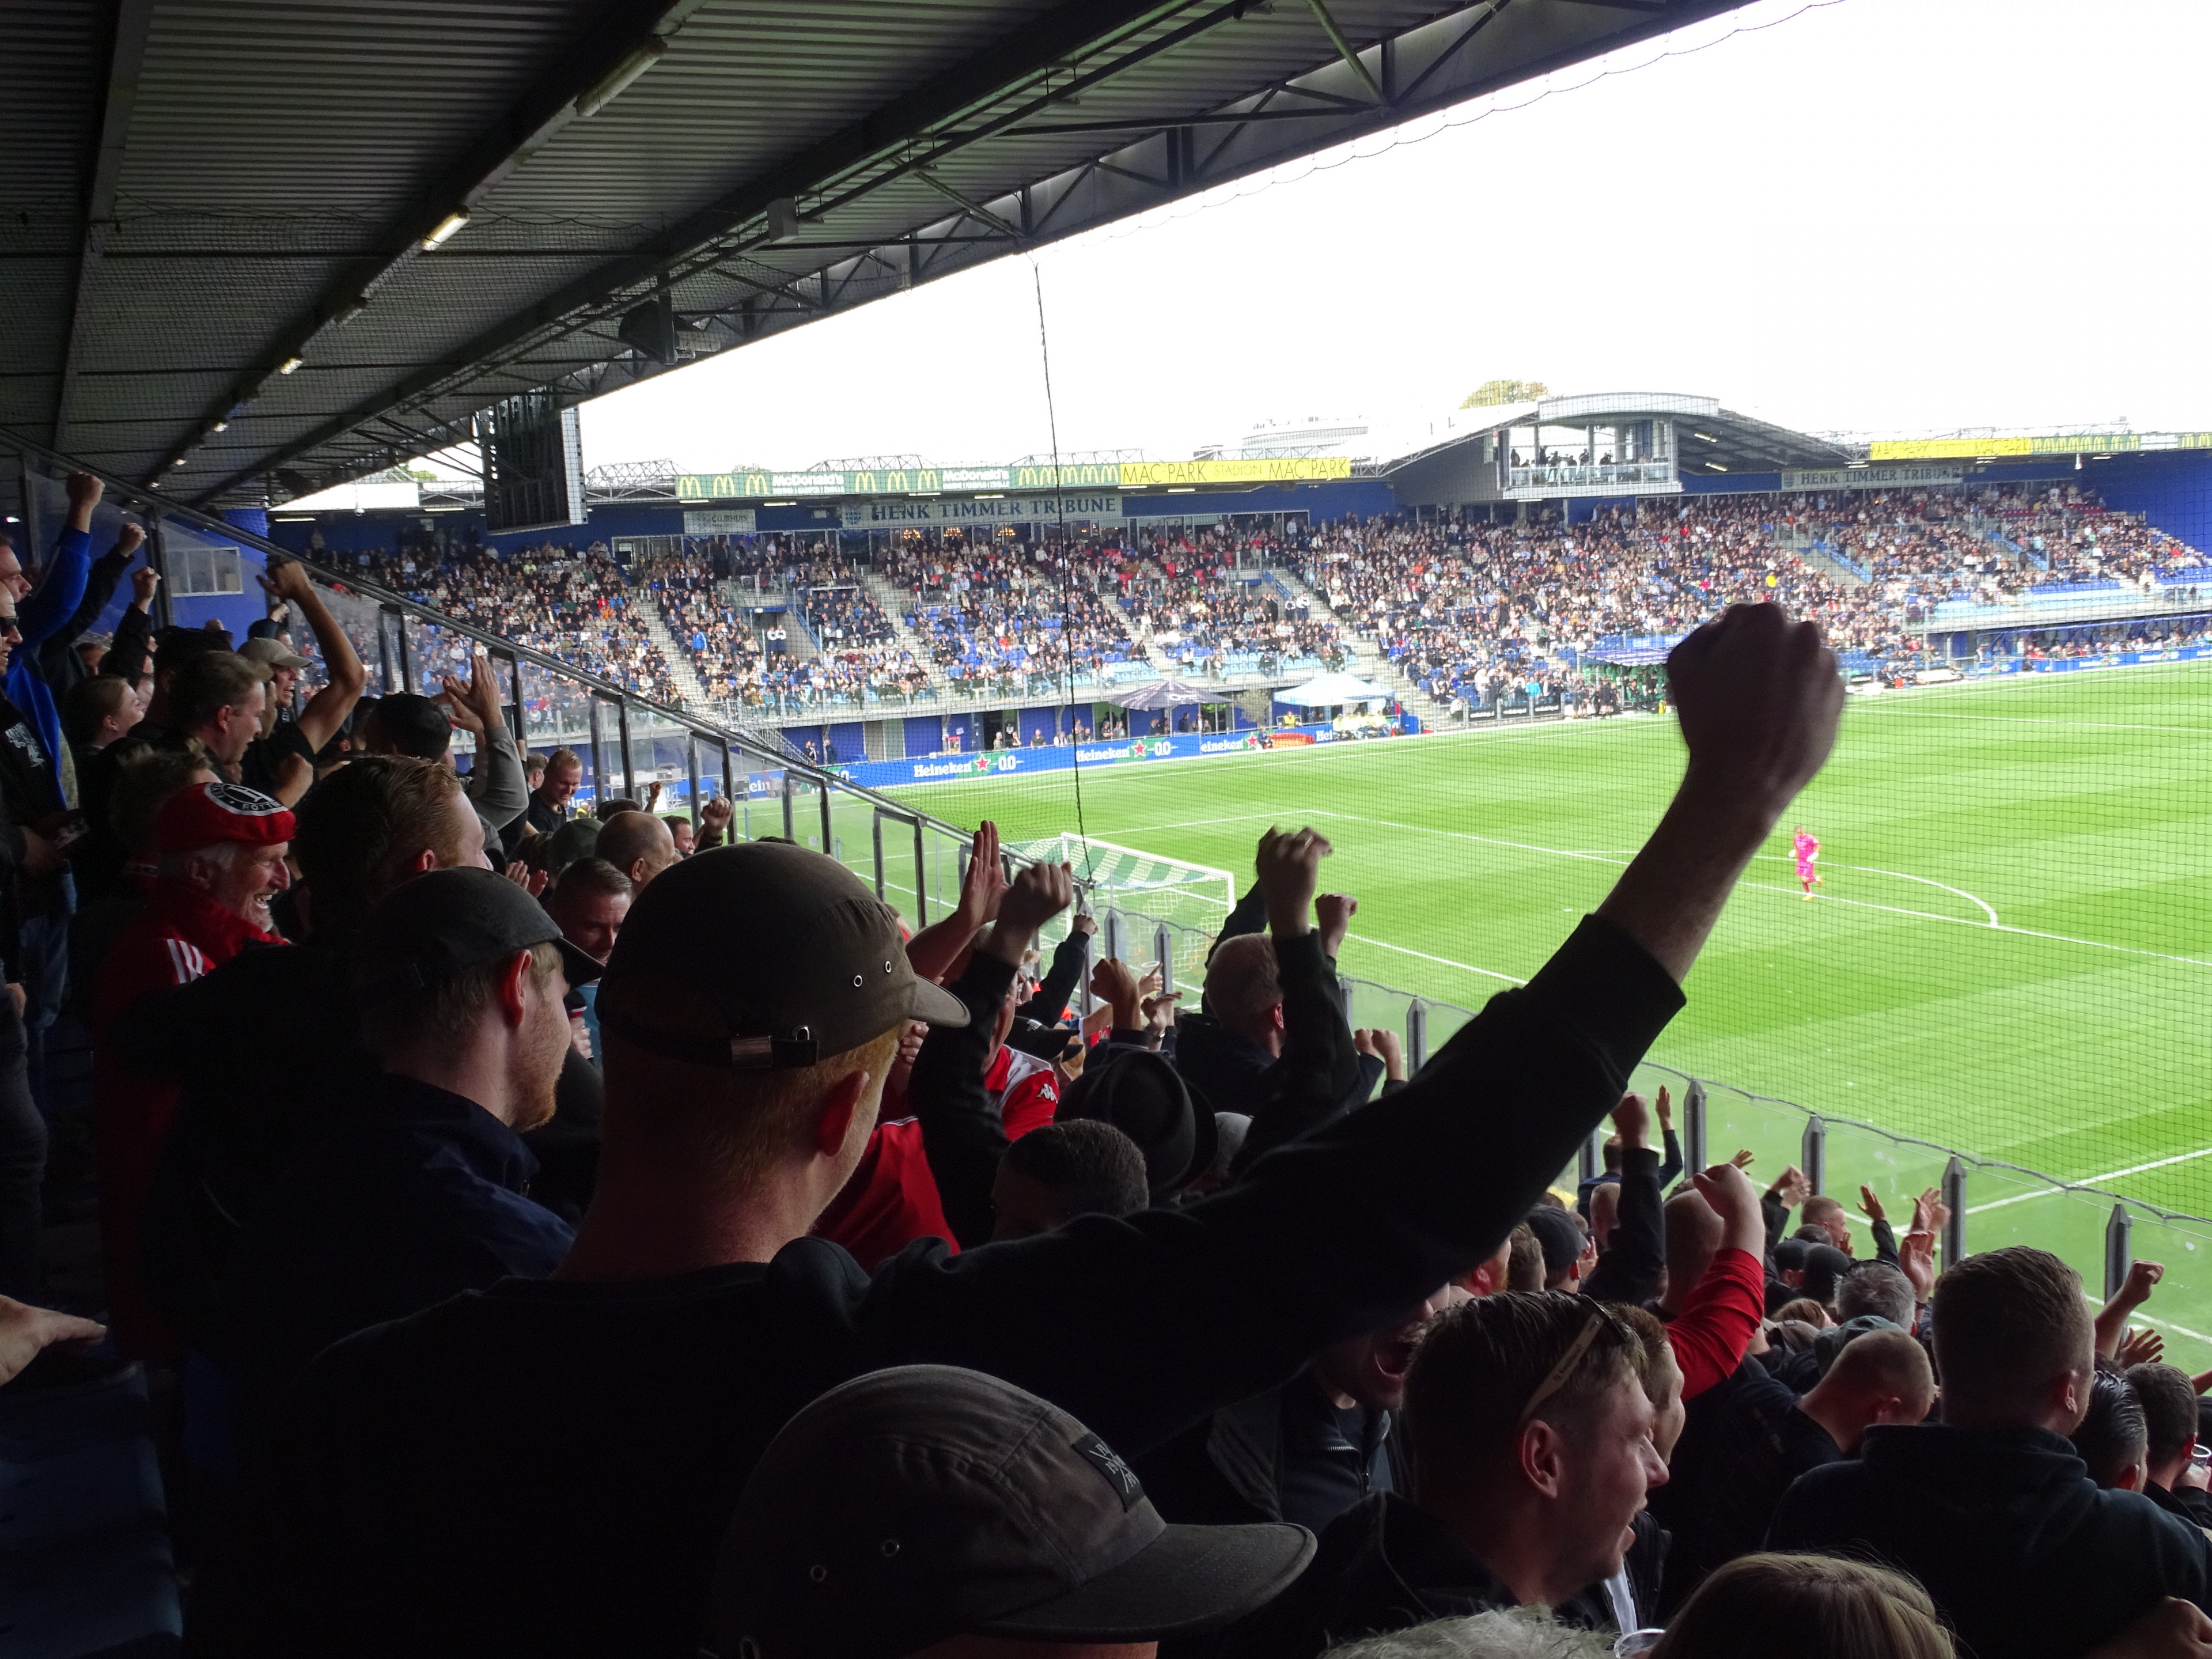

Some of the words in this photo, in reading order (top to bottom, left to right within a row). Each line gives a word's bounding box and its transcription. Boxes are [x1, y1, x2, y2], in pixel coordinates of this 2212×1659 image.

[943, 469, 1010, 482] McDonald's
[1123, 464, 1161, 484] MAC
[1168, 463, 1207, 483] PARK
[1214, 464, 1262, 476] STADION
[1269, 460, 1305, 479] MAC
[1312, 459, 1347, 478] PARK
[1801, 472, 1839, 485] HENK
[1844, 469, 1897, 482] TIMMER
[1903, 467, 1960, 480] TRIBUNE
[772, 474, 845, 486] McDonald's
[872, 504, 930, 521] HENK
[938, 501, 1022, 518] TIMMER
[1030, 498, 1116, 514] TRBUNE
[1076, 747, 1130, 762] Heineken
[914, 761, 973, 777] Heineken
